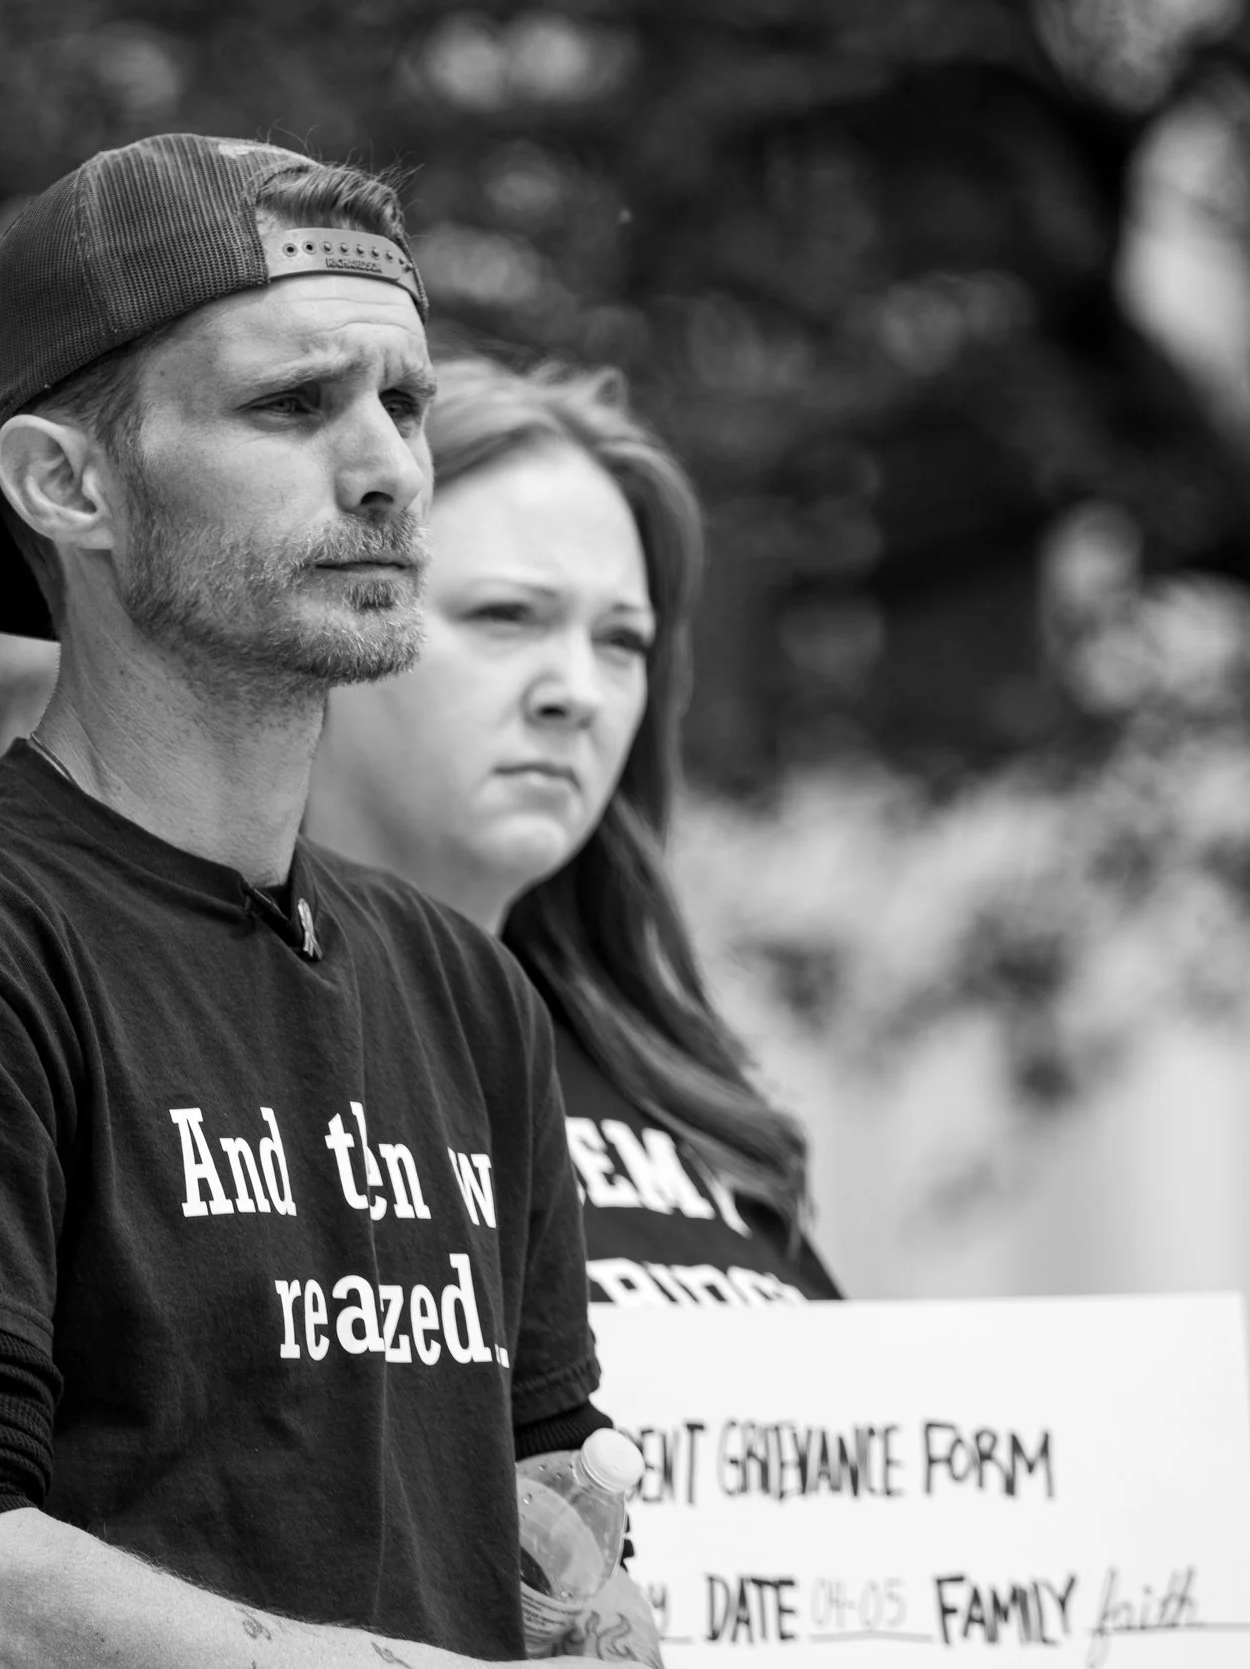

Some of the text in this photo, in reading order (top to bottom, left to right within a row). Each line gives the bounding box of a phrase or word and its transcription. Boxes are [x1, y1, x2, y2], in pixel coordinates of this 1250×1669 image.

[168, 1106, 298, 1218] And
[617, 1421, 707, 1505] ENT
[923, 1419, 1058, 1502] FORM
[705, 1573, 799, 1646] DATE
[932, 1573, 1079, 1648] FAMILY
